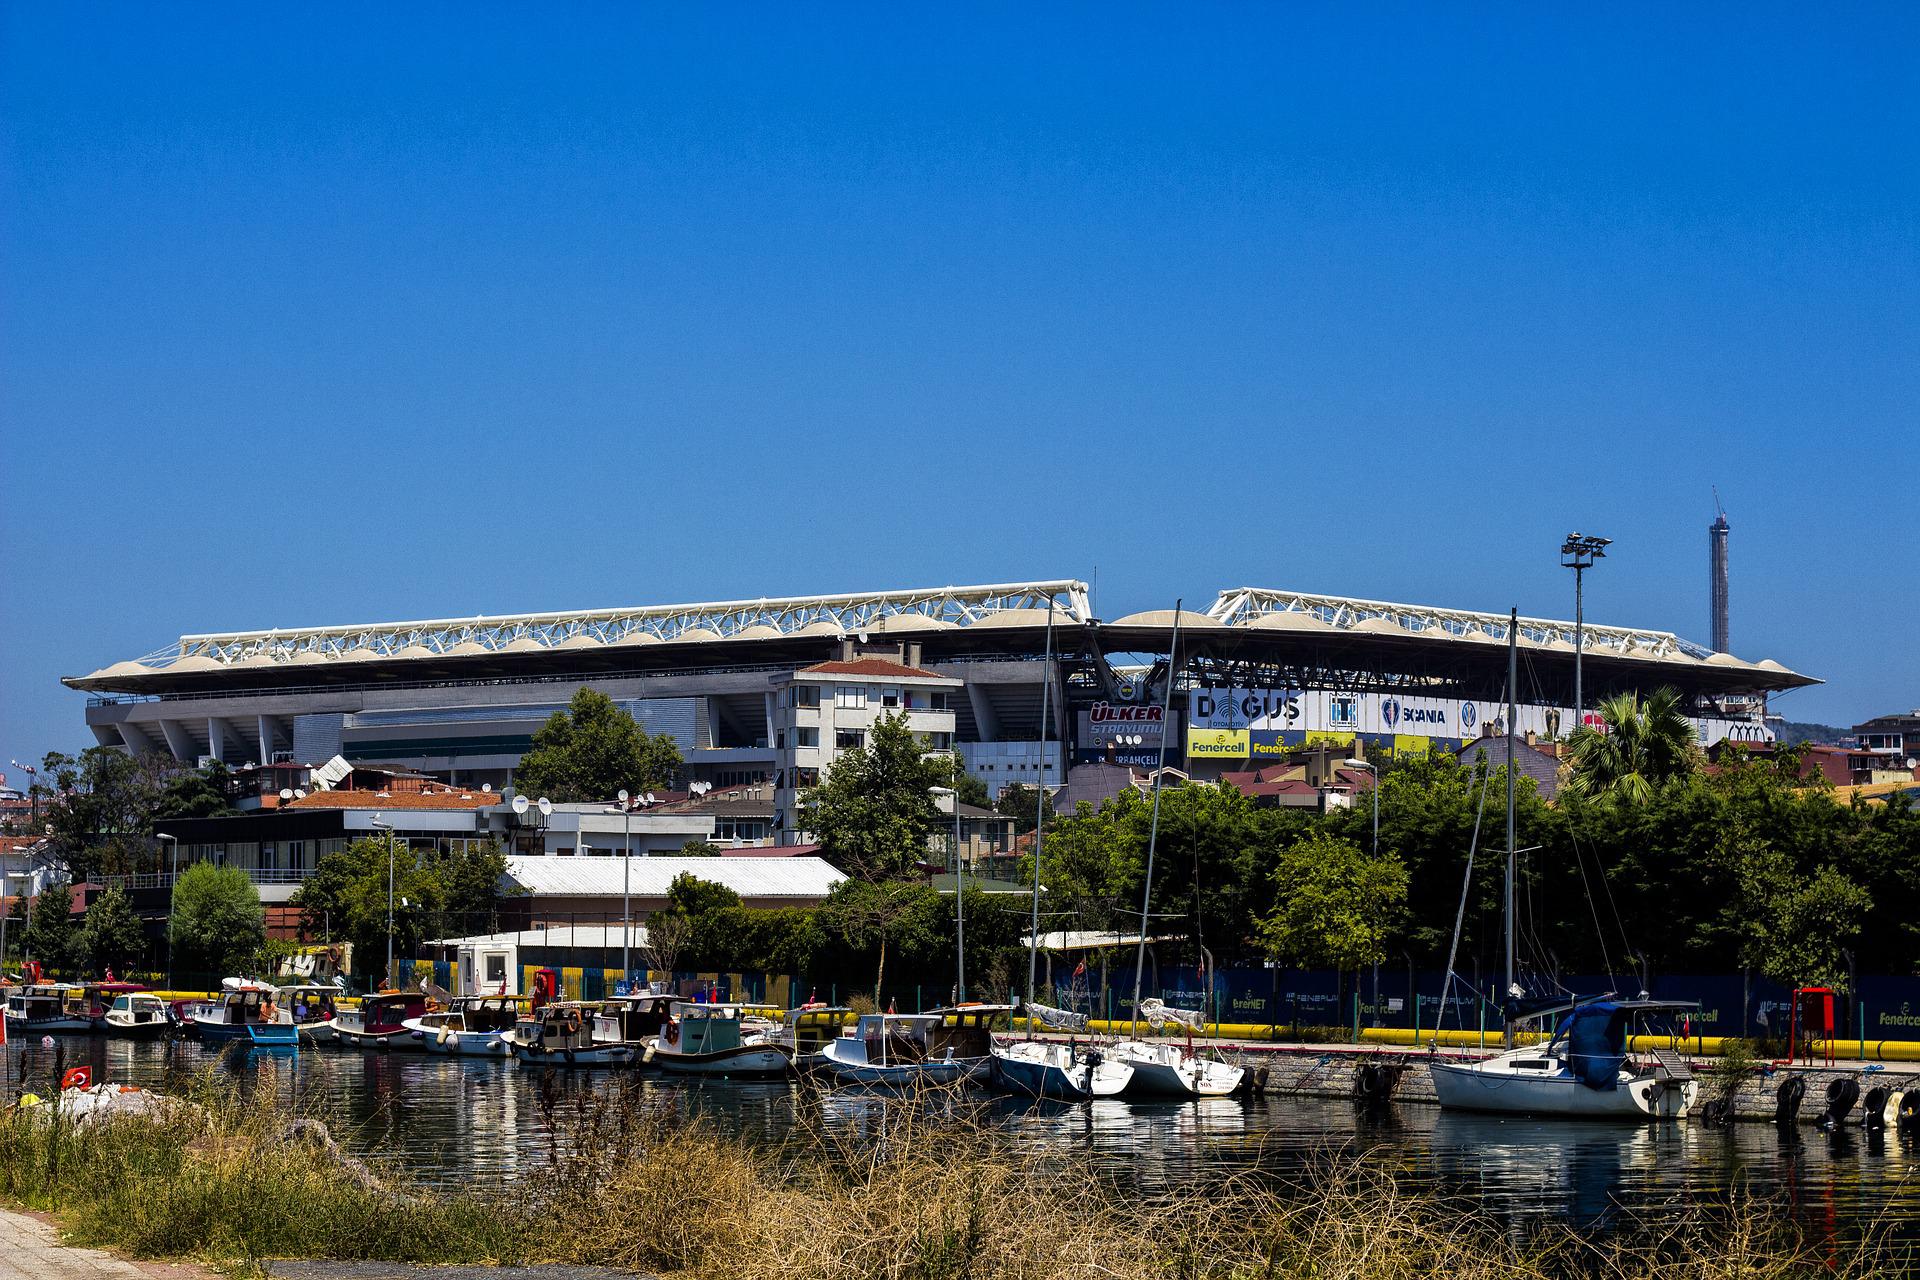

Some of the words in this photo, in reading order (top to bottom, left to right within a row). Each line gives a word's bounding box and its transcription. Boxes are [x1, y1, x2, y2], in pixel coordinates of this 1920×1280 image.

[1090, 701, 1163, 723] ÜLKER
[1403, 707, 1446, 724] SCANIA
[1090, 725, 1163, 733] STADYUMU
[1192, 742, 1245, 753] Fenercell
[1253, 742, 1295, 754] Fenerc
[1098, 753, 1158, 767] FRBAHÇELİ
